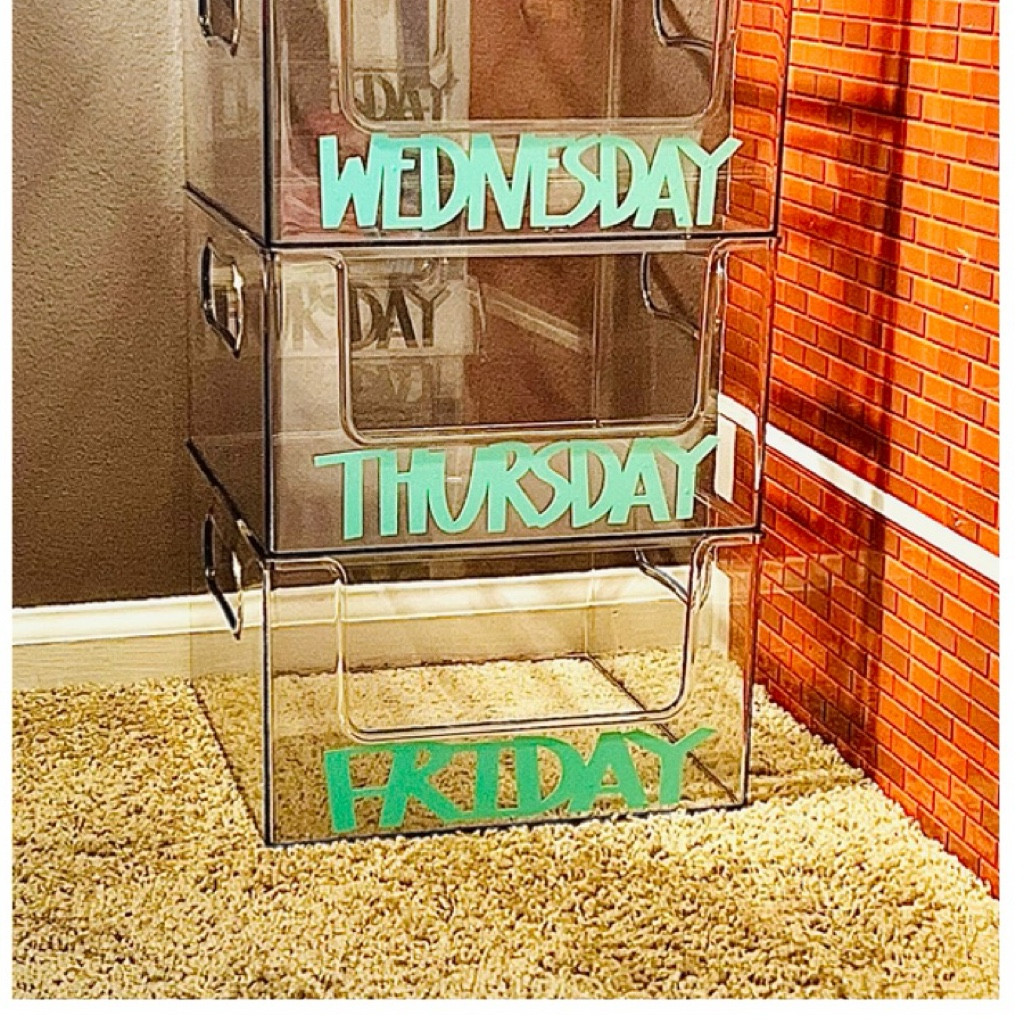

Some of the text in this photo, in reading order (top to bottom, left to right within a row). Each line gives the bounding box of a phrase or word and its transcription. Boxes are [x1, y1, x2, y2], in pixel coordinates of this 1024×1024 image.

[318, 132, 743, 230] WEDNESDAY
[314, 435, 719, 541] THURSDAY
[323, 727, 717, 833] FRIDAY
